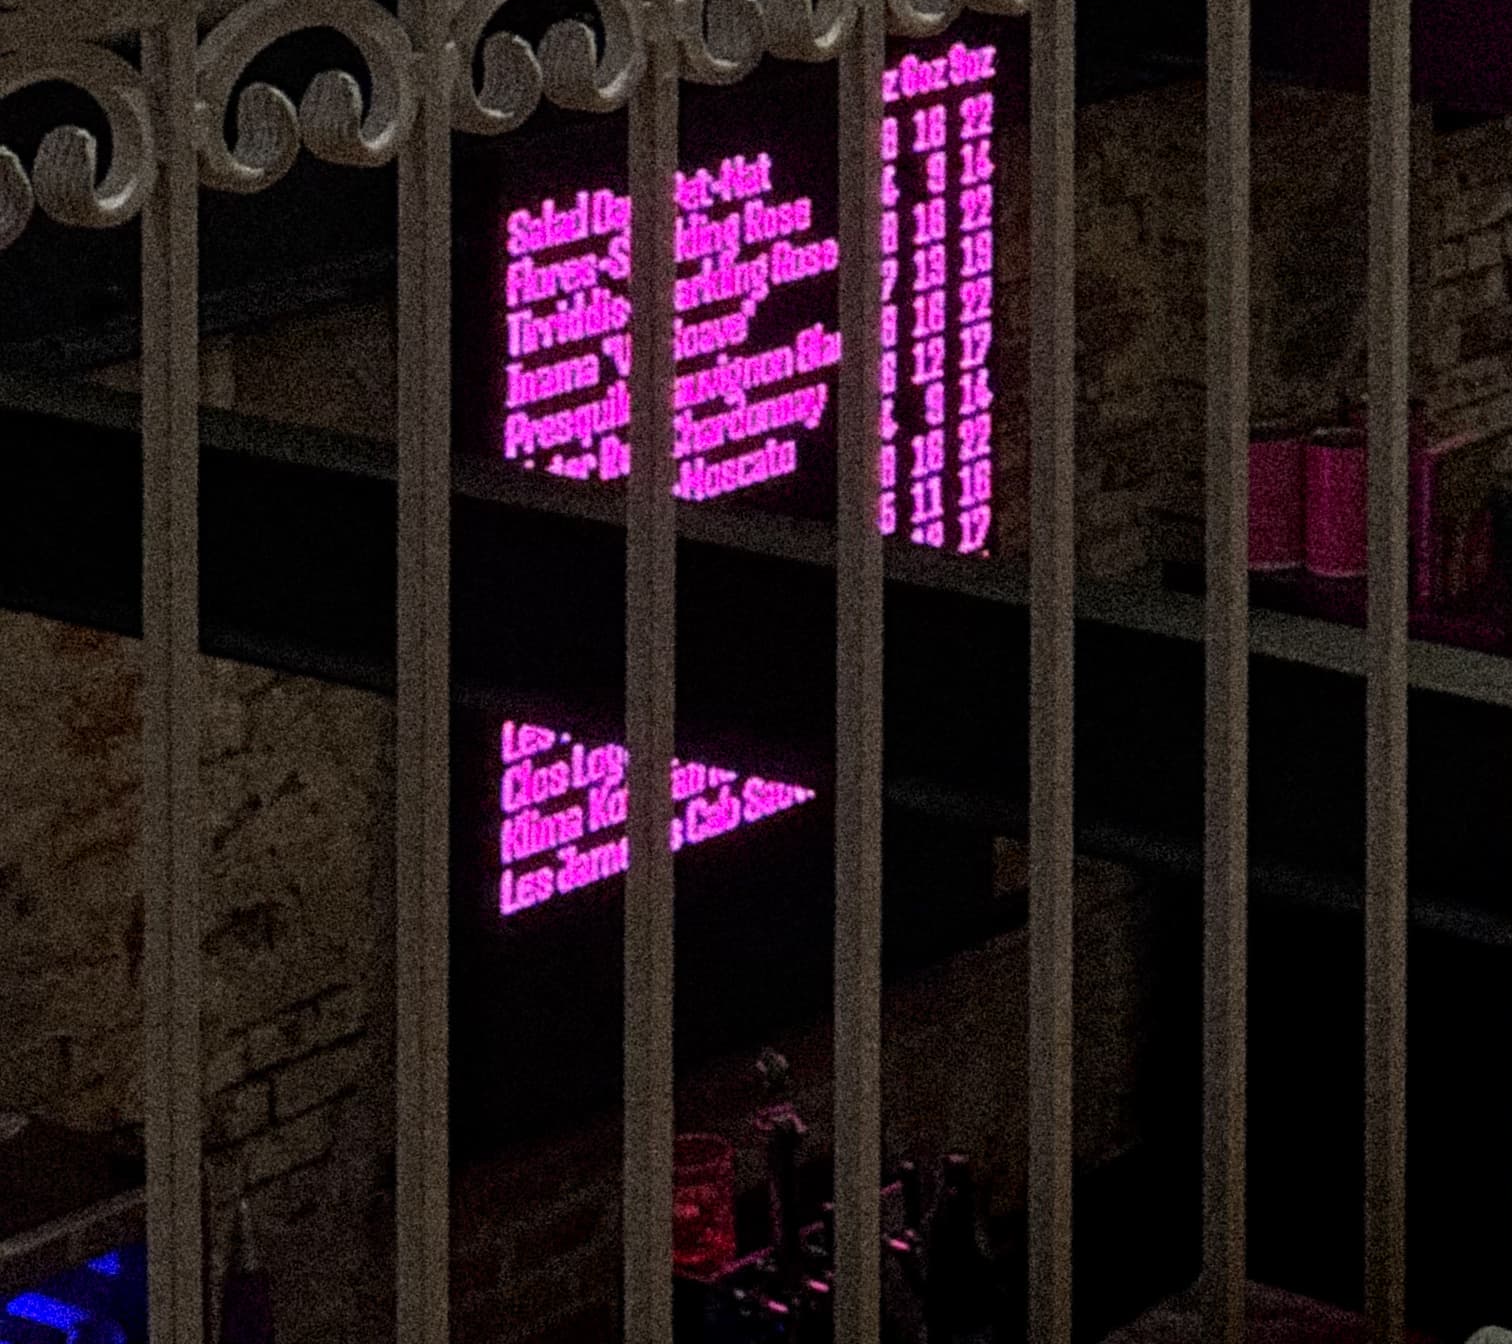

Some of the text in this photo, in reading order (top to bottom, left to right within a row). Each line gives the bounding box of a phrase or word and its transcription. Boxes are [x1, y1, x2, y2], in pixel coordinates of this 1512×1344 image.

[506, 189, 590, 257] Salad
[674, 152, 772, 211] et-Nat
[674, 254, 769, 313] arkling
[673, 345, 794, 410] auvignon
[499, 866, 555, 917] Les
[684, 784, 741, 846] Cab
